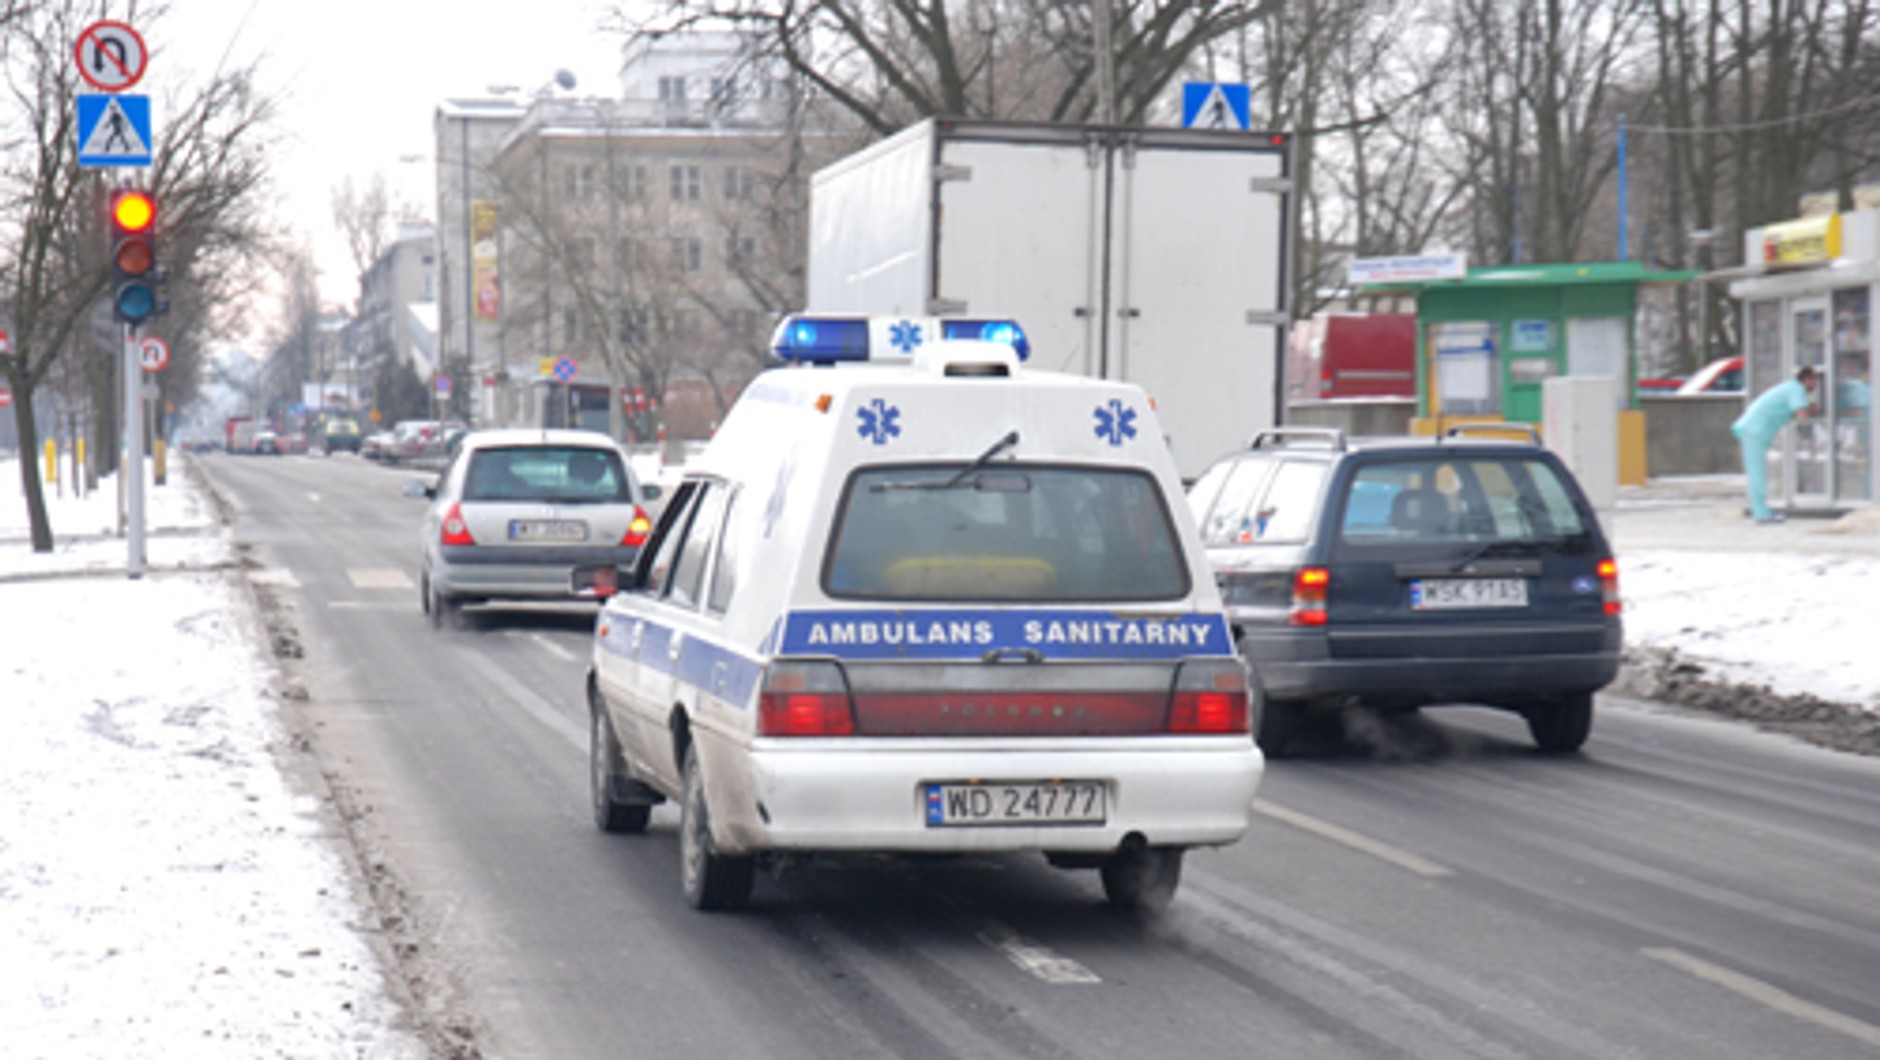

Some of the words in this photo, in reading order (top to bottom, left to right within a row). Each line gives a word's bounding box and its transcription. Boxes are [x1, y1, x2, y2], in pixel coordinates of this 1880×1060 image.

[807, 620, 994, 645] AMBULANS
[1023, 620, 1211, 645] SANITARNY
[947, 788, 993, 818] WD
[1003, 786, 1097, 817] 24777
